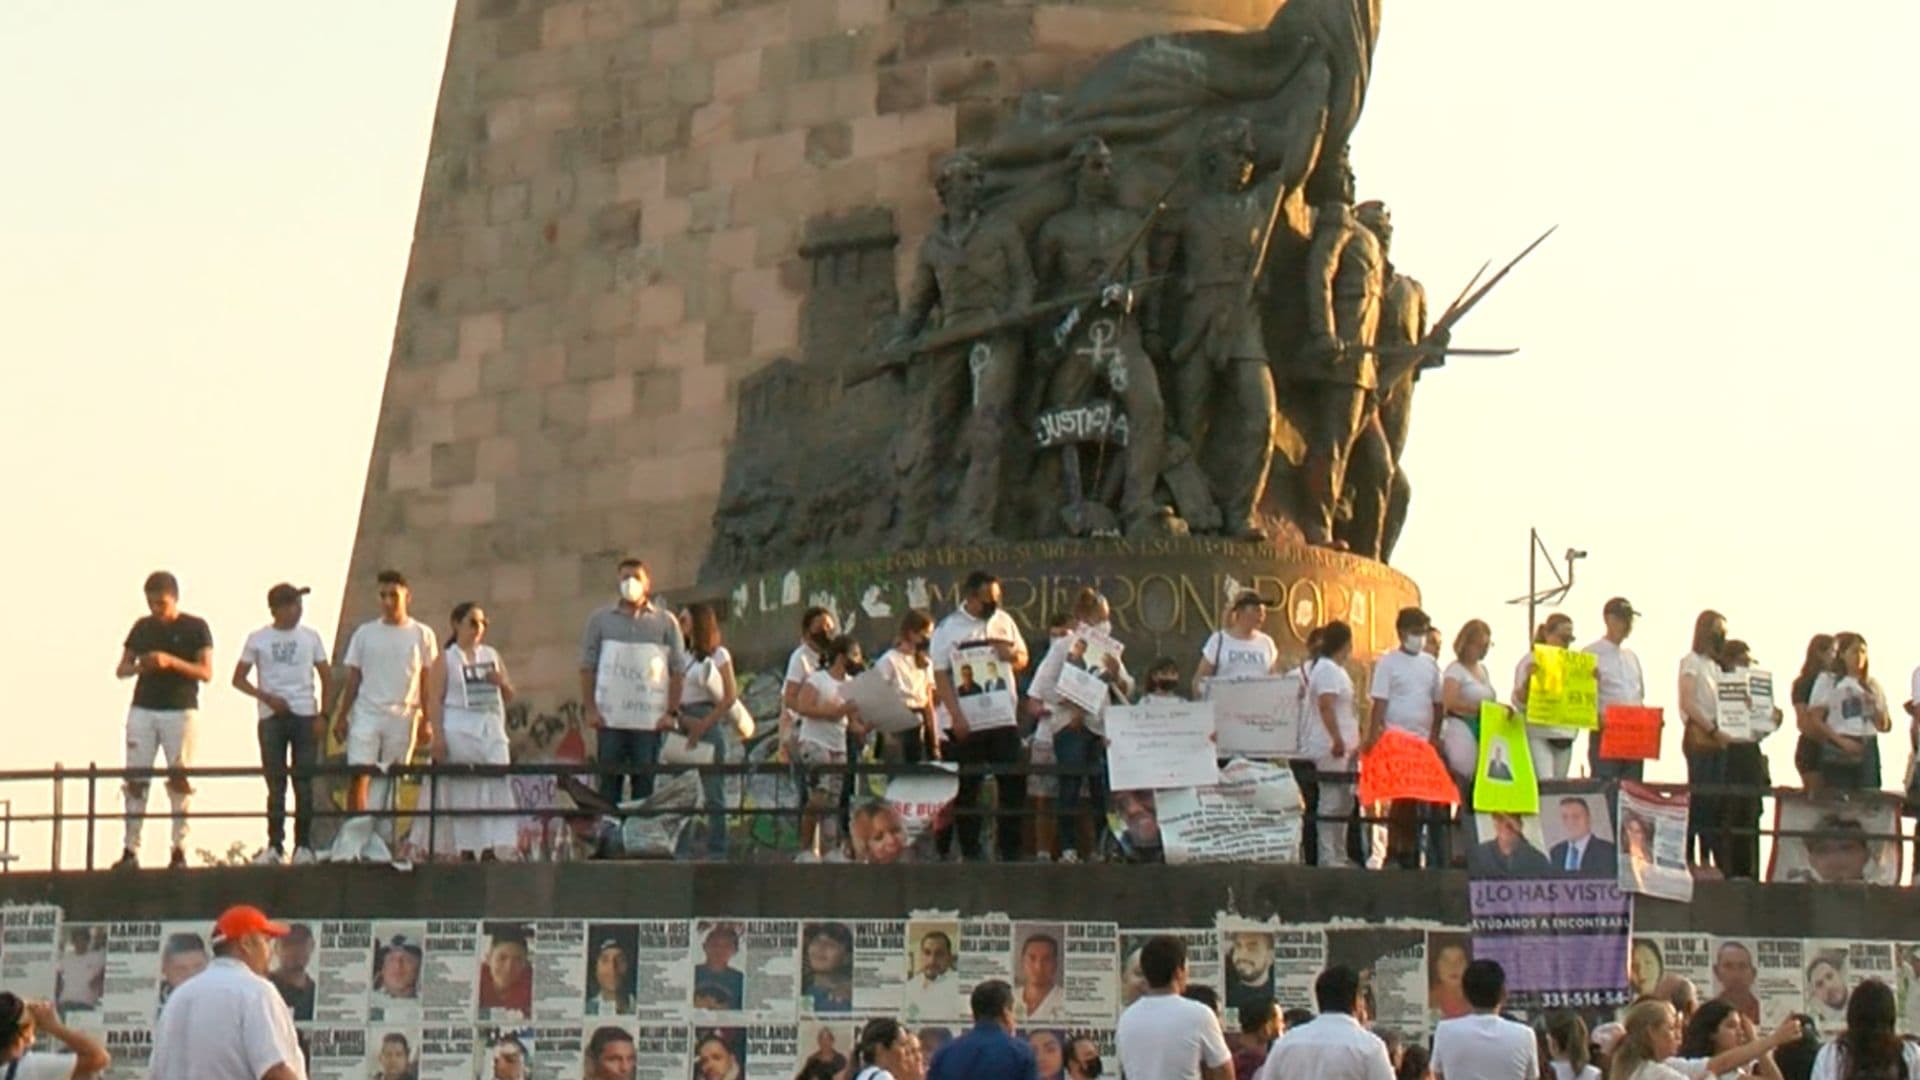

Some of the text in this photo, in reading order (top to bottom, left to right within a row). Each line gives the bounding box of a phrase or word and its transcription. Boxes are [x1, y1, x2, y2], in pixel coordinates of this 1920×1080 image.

[1037, 404, 1129, 446] JUSTICIA
[1475, 884, 1512, 907] ¿LO
[1519, 884, 1558, 900] HAS
[855, 922, 905, 935] WILLIAM
[1472, 915, 1537, 930] AYÚDANOS
[1540, 918, 1549, 929] A
[109, 923, 162, 937] RAMIRO
[749, 1026, 798, 1040] ORLANDO
